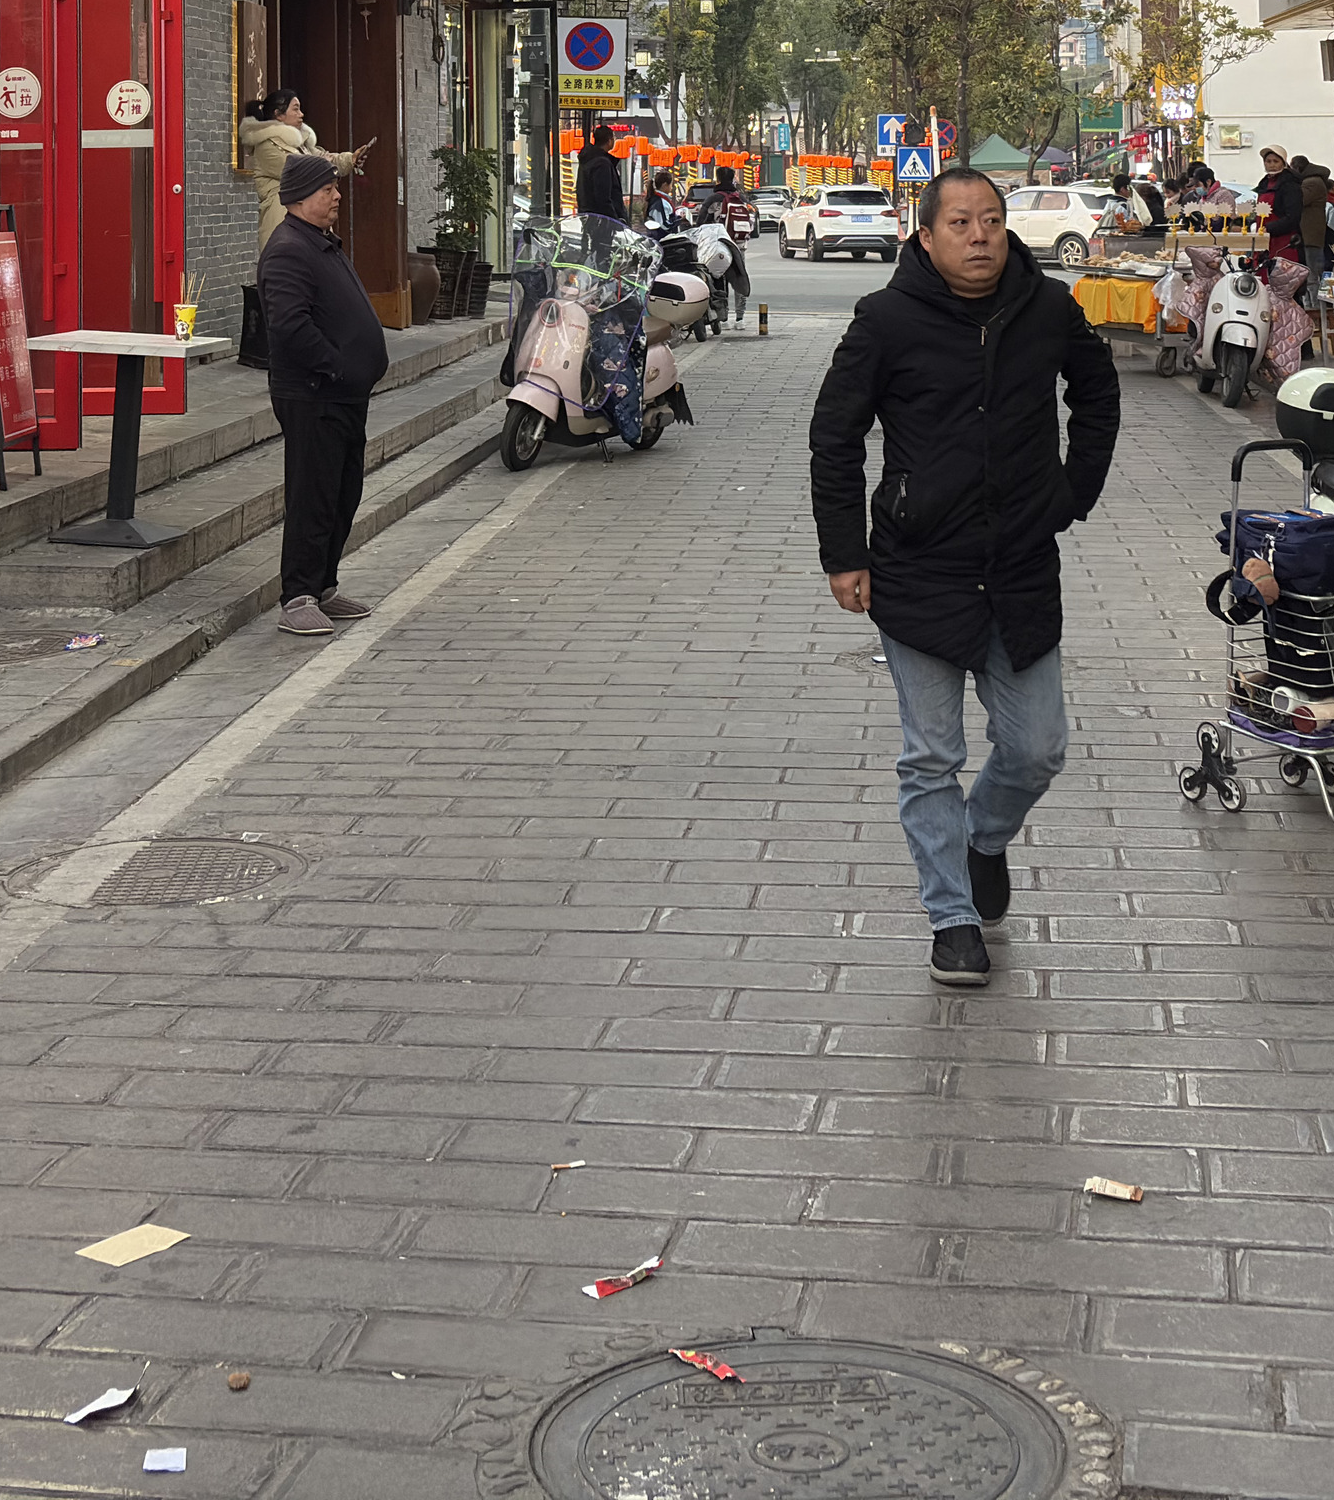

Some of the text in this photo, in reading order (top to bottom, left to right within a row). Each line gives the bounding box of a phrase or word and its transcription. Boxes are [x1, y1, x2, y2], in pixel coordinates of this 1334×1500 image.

[564, 78, 615, 90] 全路段禁停
[19, 93, 33, 107] 拉
[130, 103, 143, 115] 推
